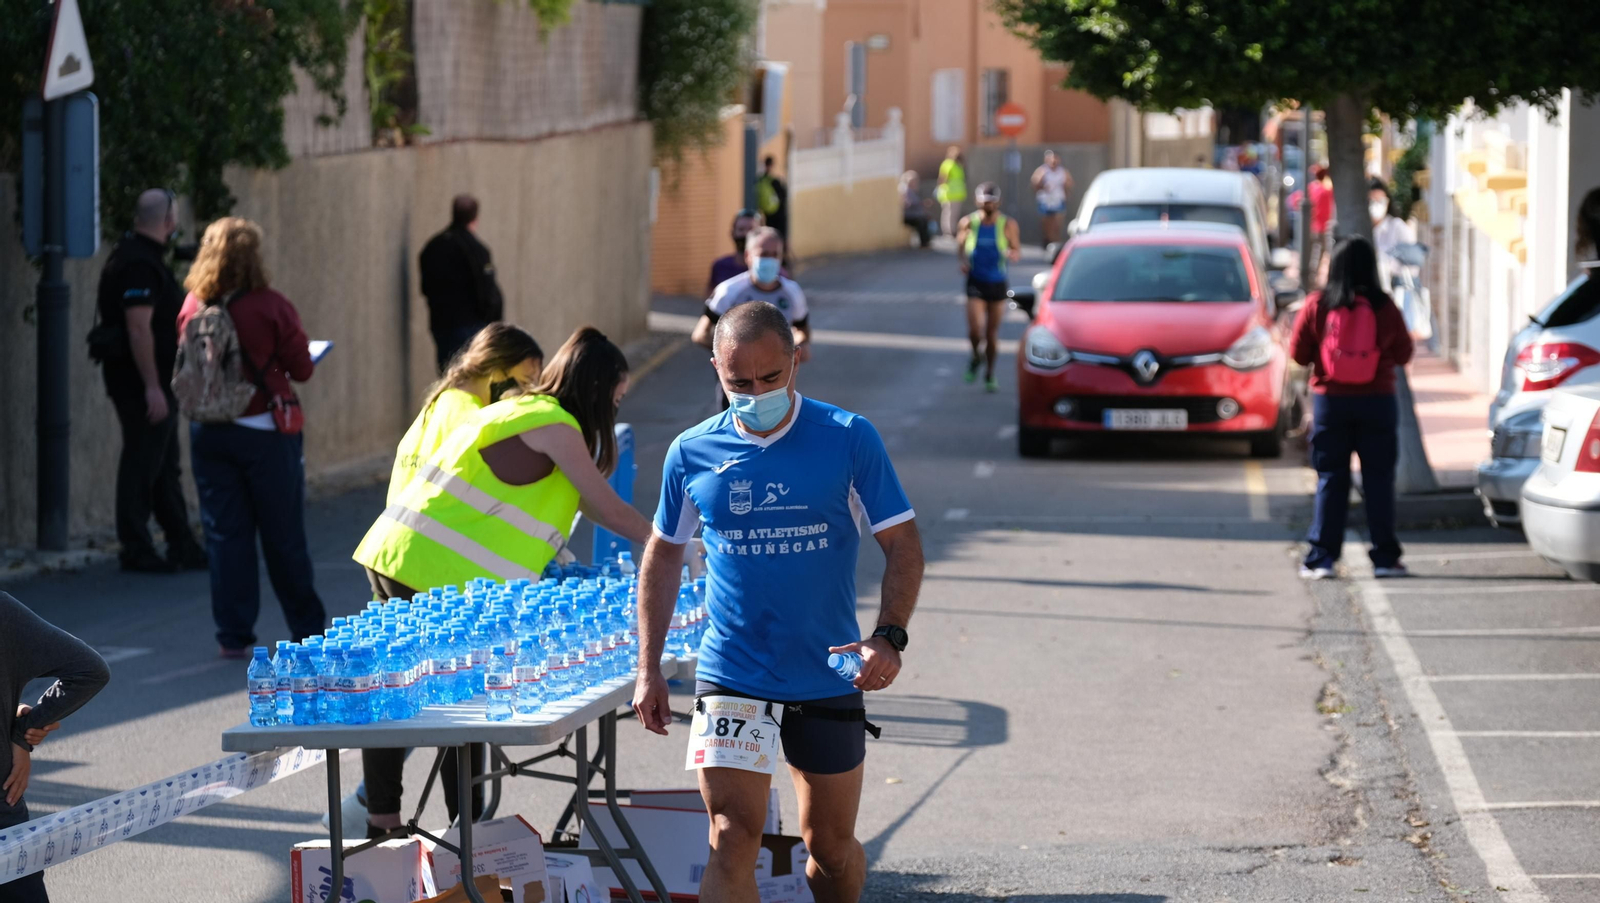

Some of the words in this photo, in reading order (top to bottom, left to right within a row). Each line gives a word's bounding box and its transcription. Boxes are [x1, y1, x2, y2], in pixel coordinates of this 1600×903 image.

[748, 522, 828, 540] ATLETISMO
[718, 538, 828, 555] ALMUÑÉCAR
[715, 717, 746, 738] 87
[705, 739, 735, 748] CARMEN
[738, 740, 744, 750] Y
[745, 742, 760, 752] EDU
